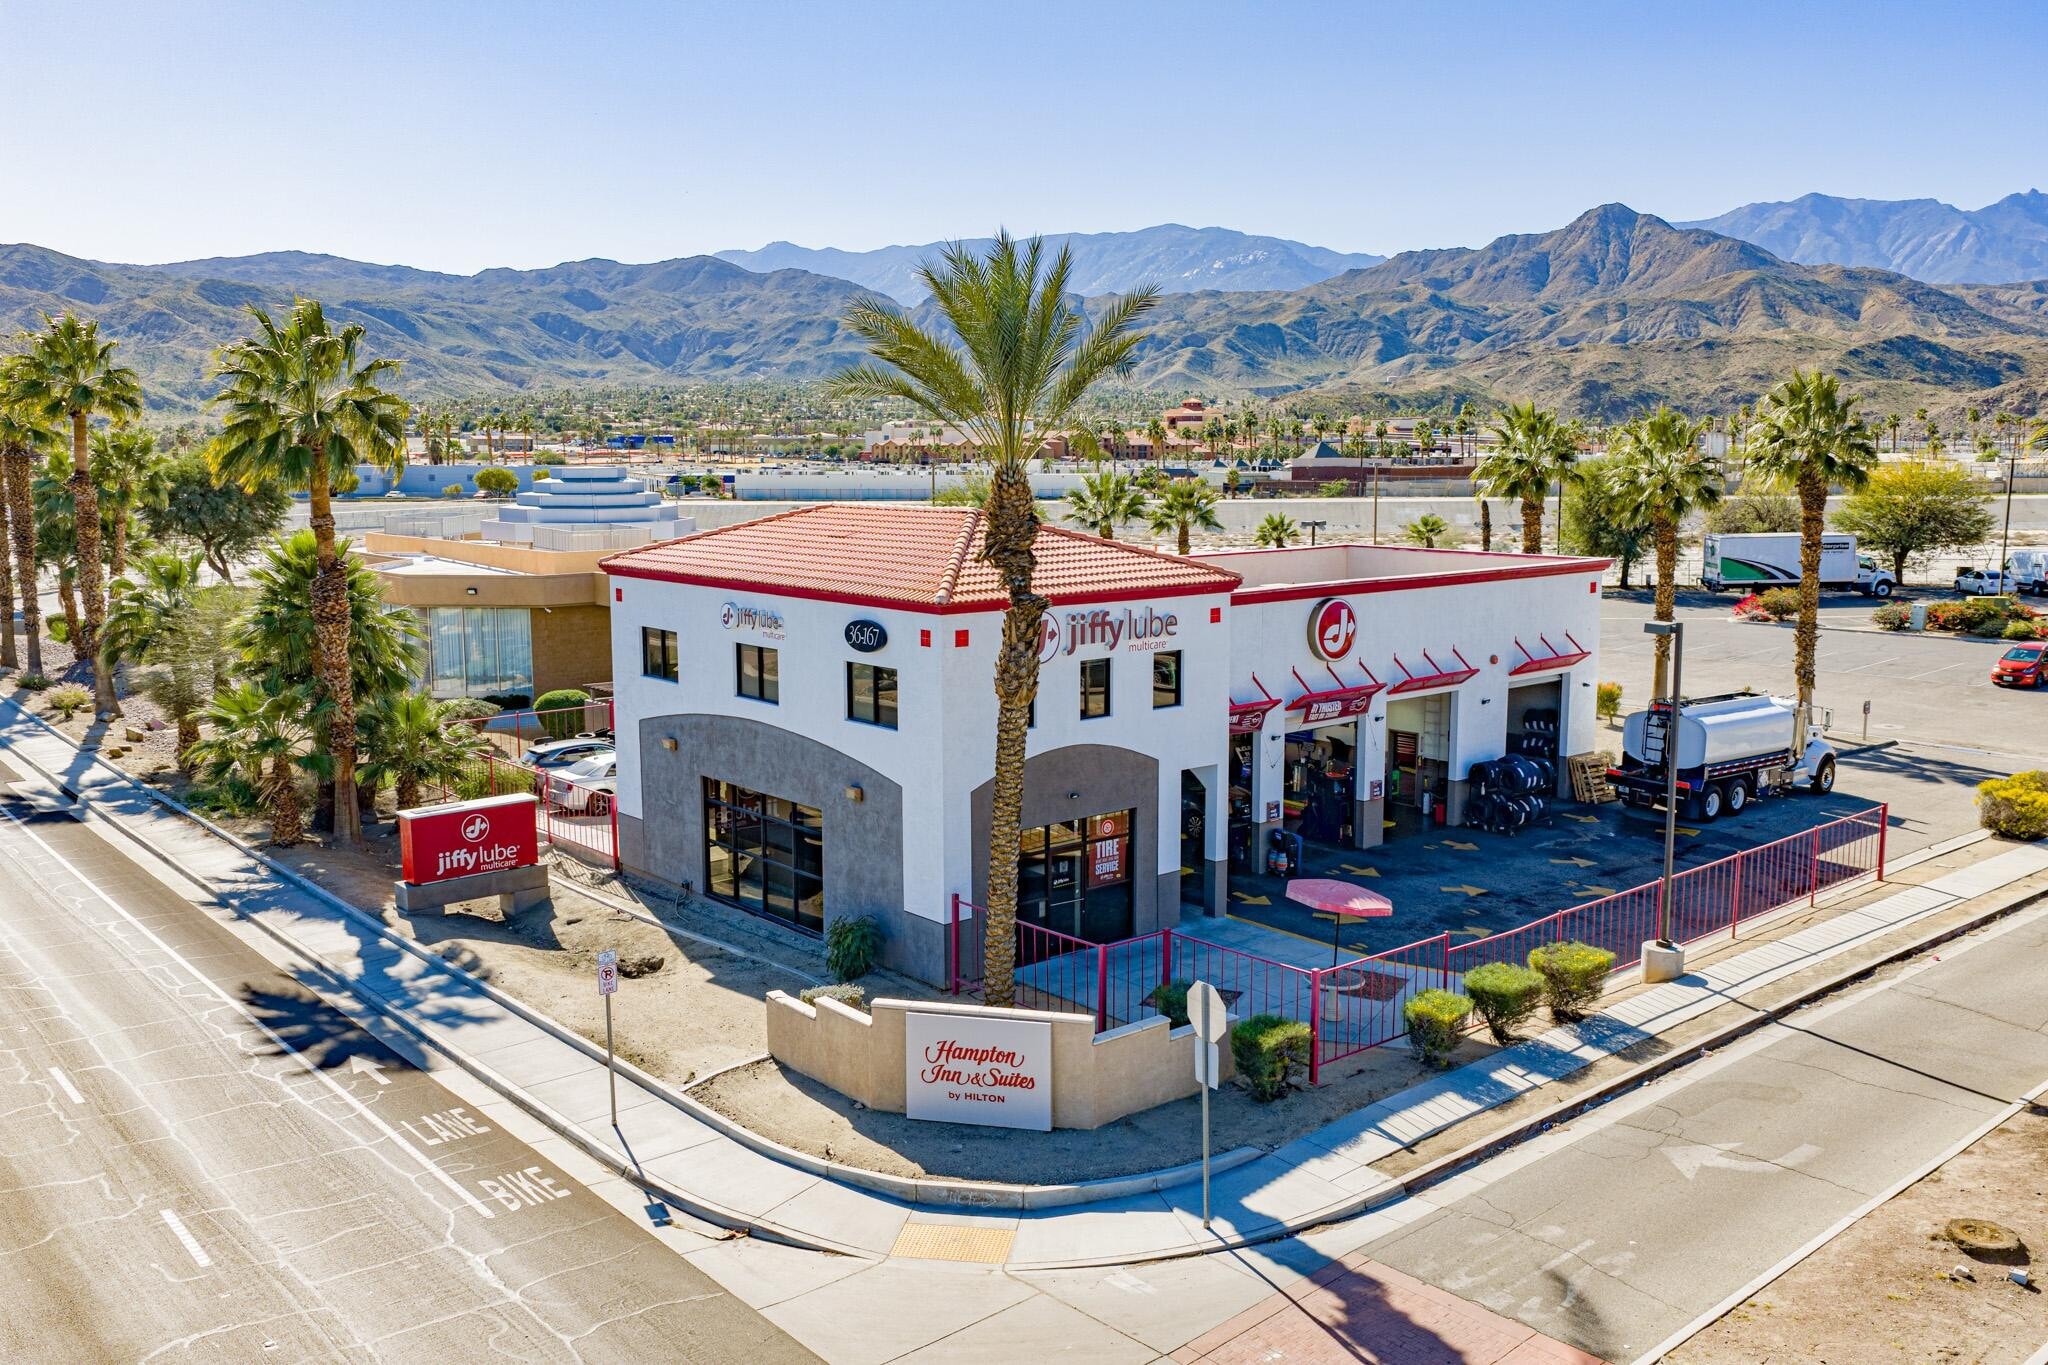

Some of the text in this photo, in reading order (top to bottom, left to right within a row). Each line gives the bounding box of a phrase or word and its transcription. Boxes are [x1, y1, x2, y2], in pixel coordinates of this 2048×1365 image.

[736, 608, 779, 630] jiffy lube
[848, 624, 880, 647] 36-167
[1066, 607, 1178, 656] jiffy lube
[1128, 640, 1167, 652] multicare
[436, 843, 518, 876] jiffy lube
[1095, 838, 1120, 859] TIRE
[480, 858, 517, 871] multicare
[1095, 859, 1119, 875] SERVICE
[925, 1040, 1025, 1067] Hampton
[921, 1064, 1035, 1089] Inn & Suites
[948, 1091, 1005, 1103] by HILTON
[400, 1107, 492, 1146] LANE
[477, 1166, 572, 1212] BIKE
